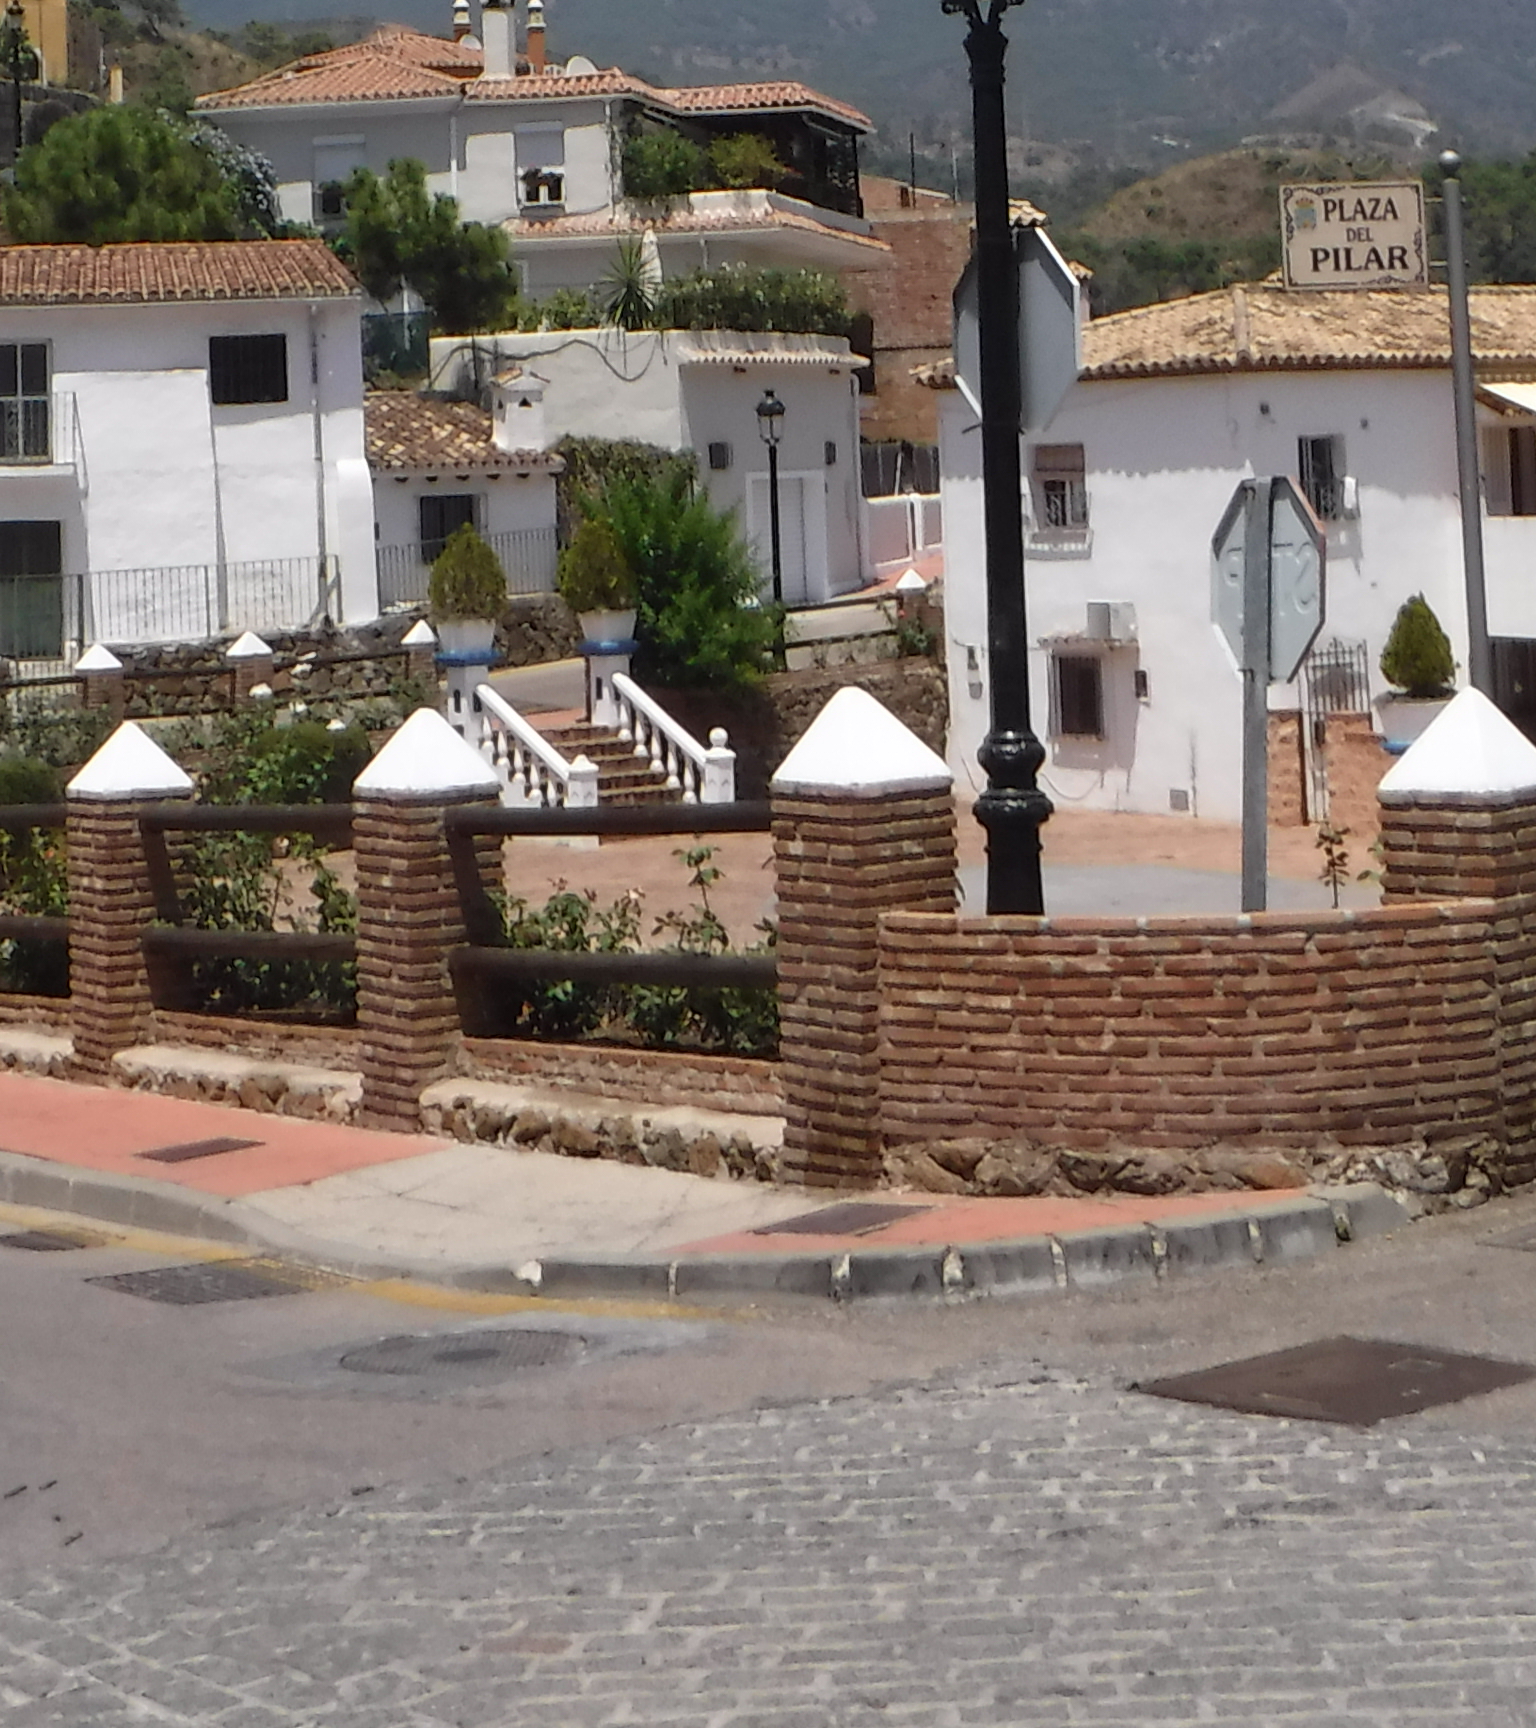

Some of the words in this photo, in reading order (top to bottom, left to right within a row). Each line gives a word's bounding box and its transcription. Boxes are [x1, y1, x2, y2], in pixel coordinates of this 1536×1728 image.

[1323, 197, 1399, 222] PLAZA
[1346, 227, 1374, 242] DEL
[1310, 246, 1409, 272] PILAR
